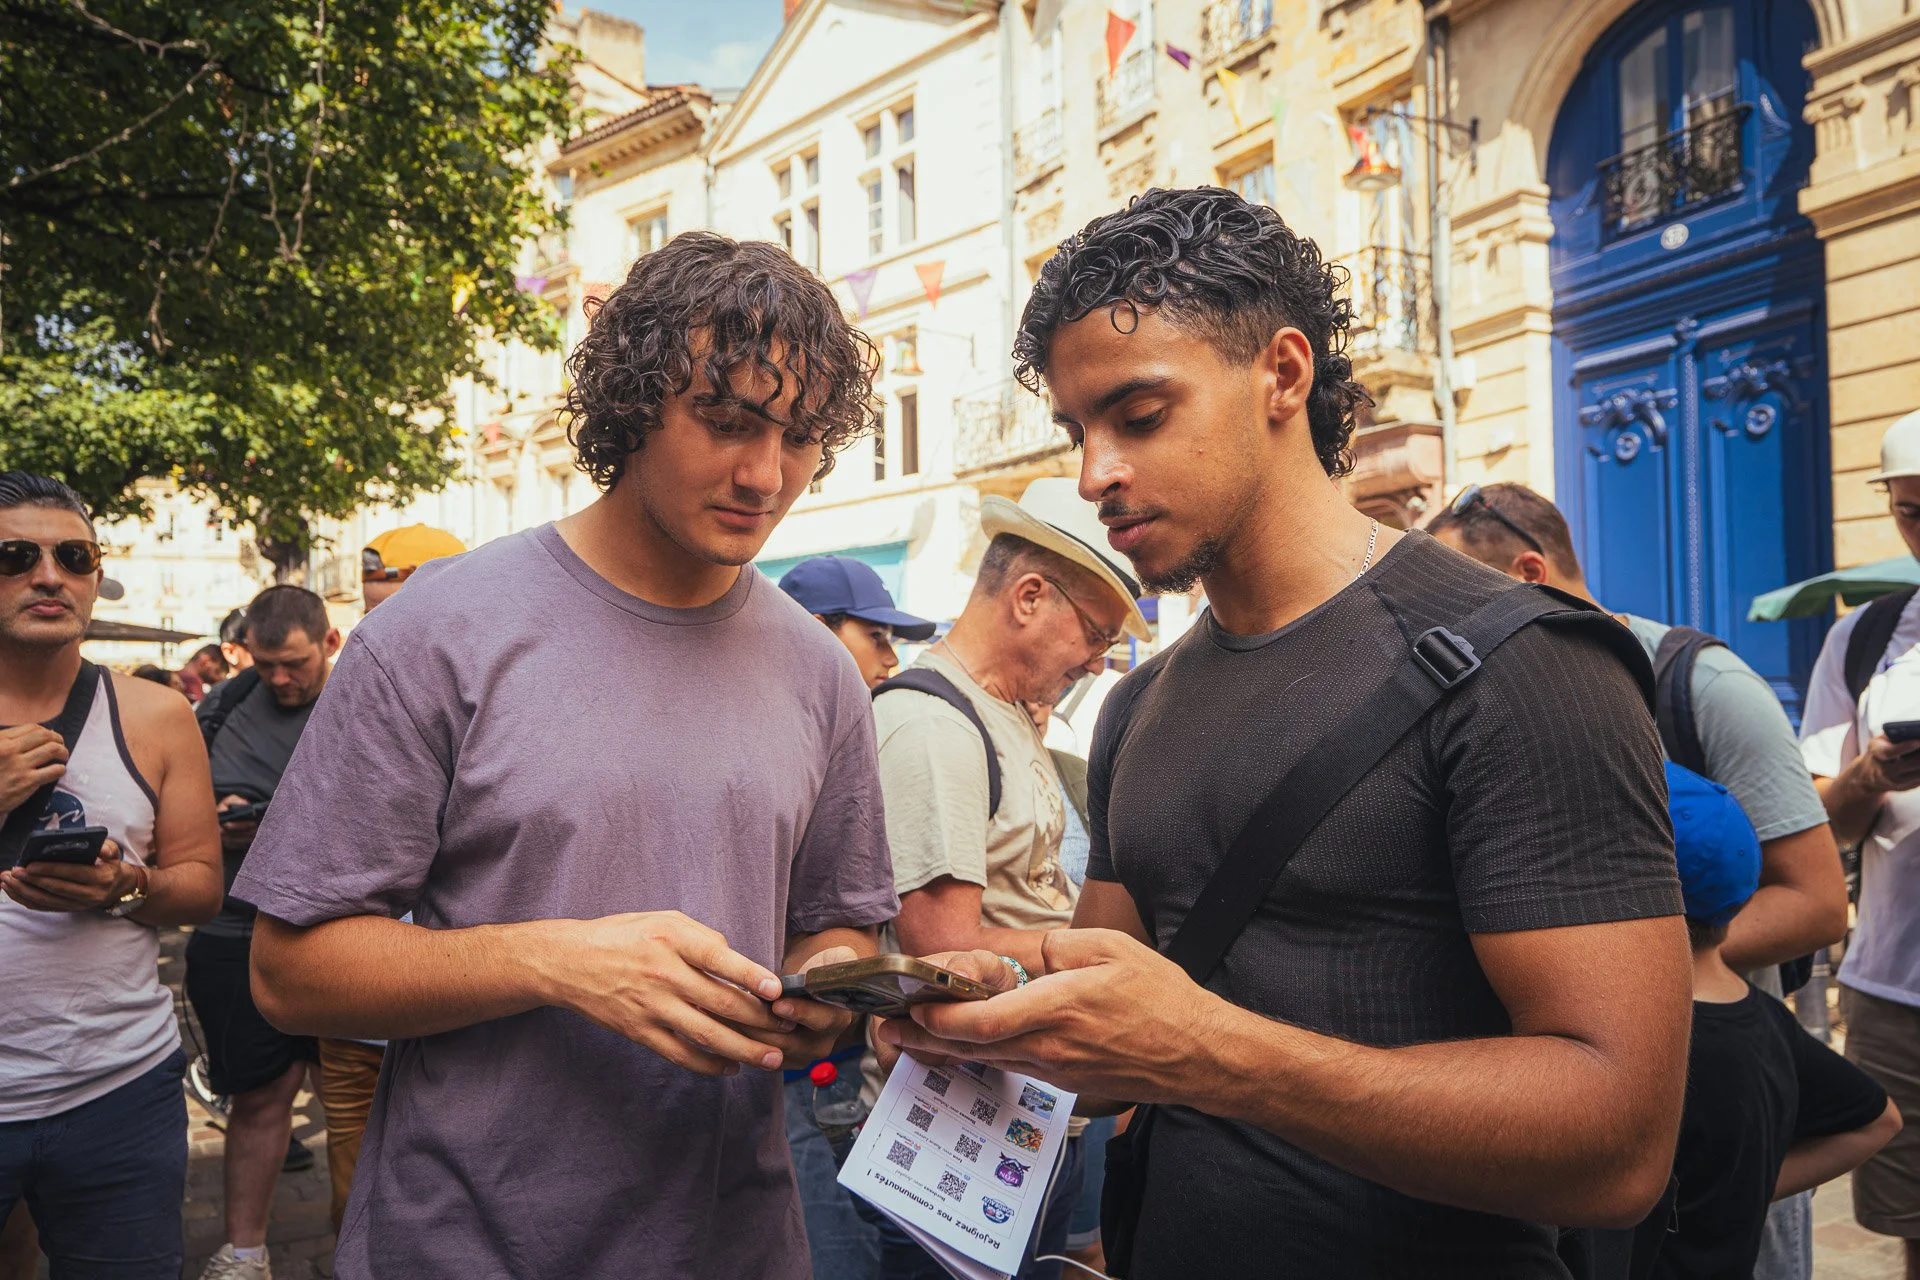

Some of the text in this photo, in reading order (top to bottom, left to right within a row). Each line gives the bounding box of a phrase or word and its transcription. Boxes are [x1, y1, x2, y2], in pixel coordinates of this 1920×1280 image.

[998, 1170, 1019, 1183] IZON
[875, 1173, 934, 1210] communautés
[937, 1210, 952, 1221] nos
[956, 1220, 1000, 1249] Rejoignez
